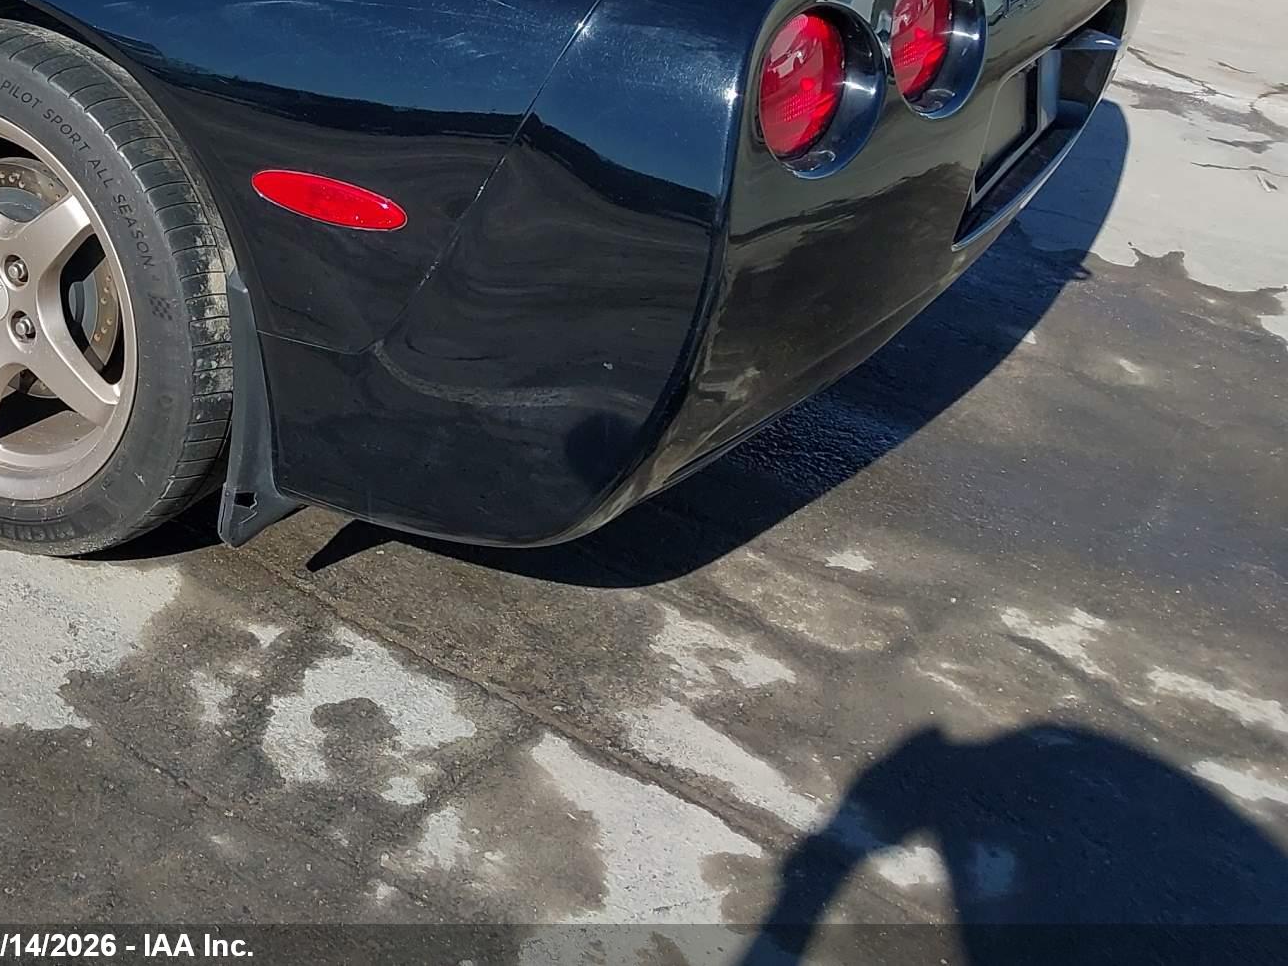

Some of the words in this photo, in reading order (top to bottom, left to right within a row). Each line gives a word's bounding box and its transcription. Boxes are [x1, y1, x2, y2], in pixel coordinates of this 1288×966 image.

[0, 80, 43, 109] PILOT
[42, 109, 91, 152] SPORT
[87, 158, 114, 189] ALL
[113, 193, 155, 268] SEASON
